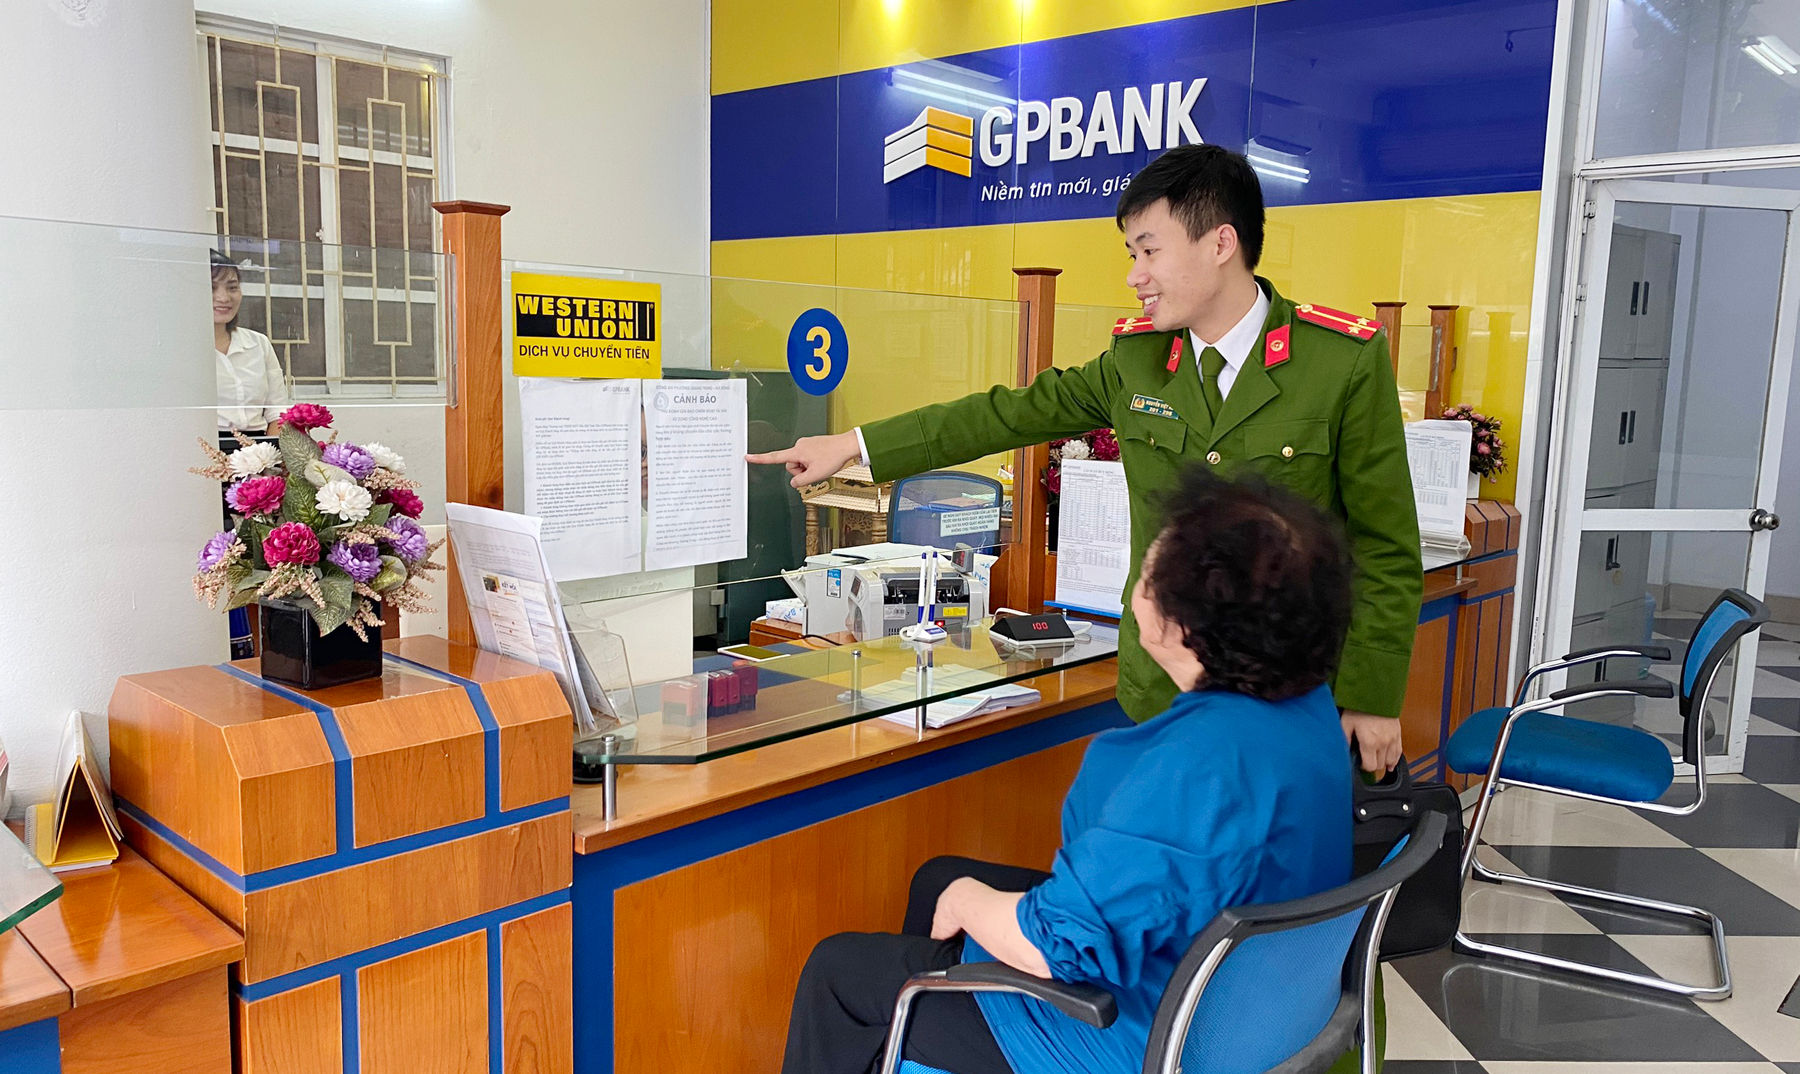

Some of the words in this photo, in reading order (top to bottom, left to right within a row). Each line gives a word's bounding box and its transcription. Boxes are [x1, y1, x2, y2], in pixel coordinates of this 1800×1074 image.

[979, 77, 1208, 168] GPBANK
[981, 180, 1024, 202] Niềm
[1029, 181, 1051, 198] tin
[517, 295, 634, 320] WESTERN
[556, 317, 634, 339] UNION
[519, 344, 549, 358] DỊCH
[552, 345, 570, 359] VỤ
[573, 344, 622, 359] CHUYỂN
[805, 326, 832, 381] 3
[673, 393, 698, 404] CẢNH
[699, 393, 717, 404] BÁO
[1032, 621, 1048, 630] 100
